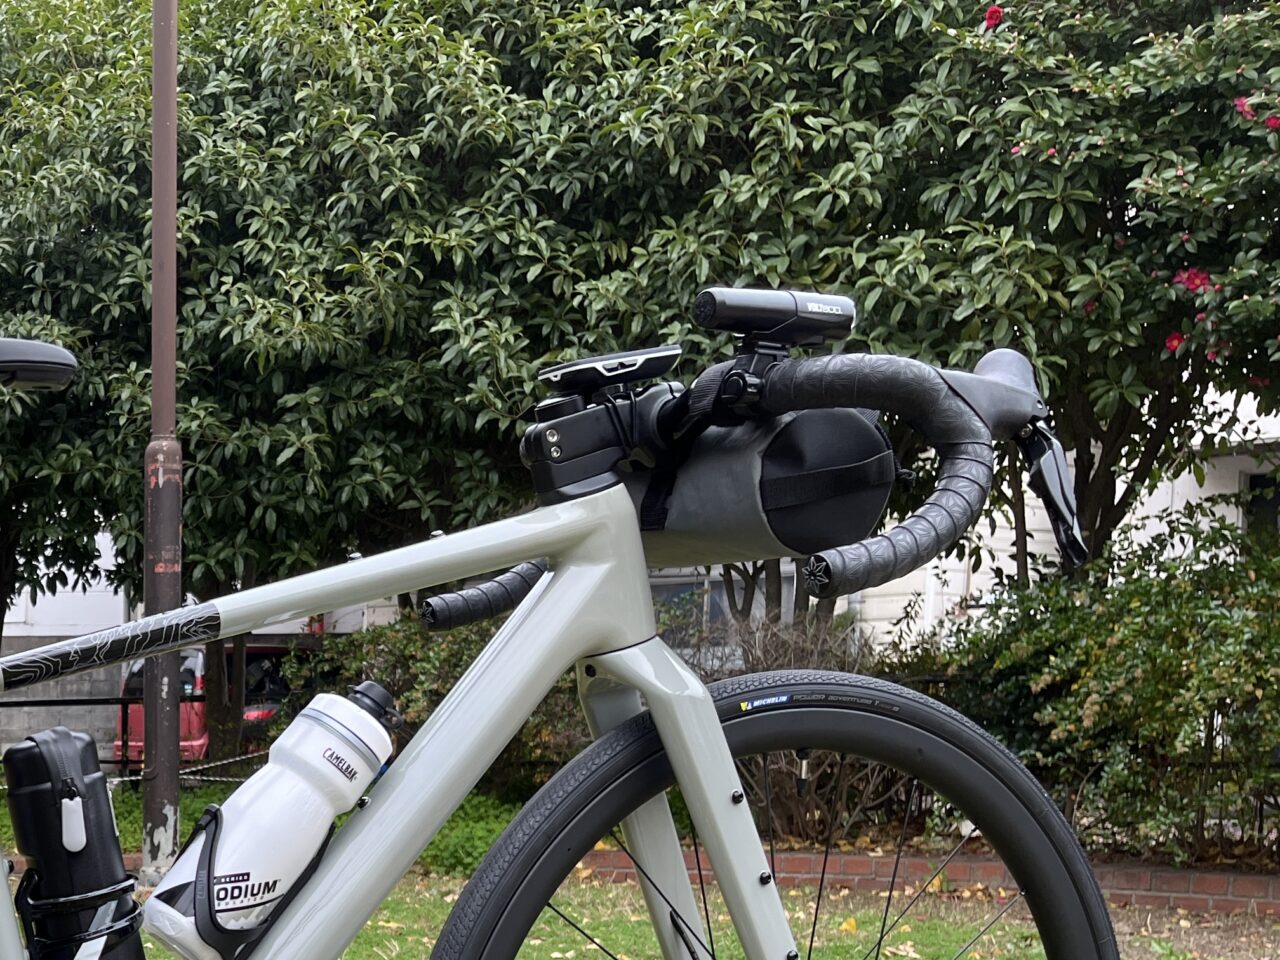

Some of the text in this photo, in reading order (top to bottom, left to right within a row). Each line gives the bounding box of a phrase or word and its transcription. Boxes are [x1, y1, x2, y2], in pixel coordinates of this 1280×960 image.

[753, 695, 788, 707] MICHELIN
[322, 747, 358, 782] CAMELBAK
[216, 879, 278, 901] ODIUM
